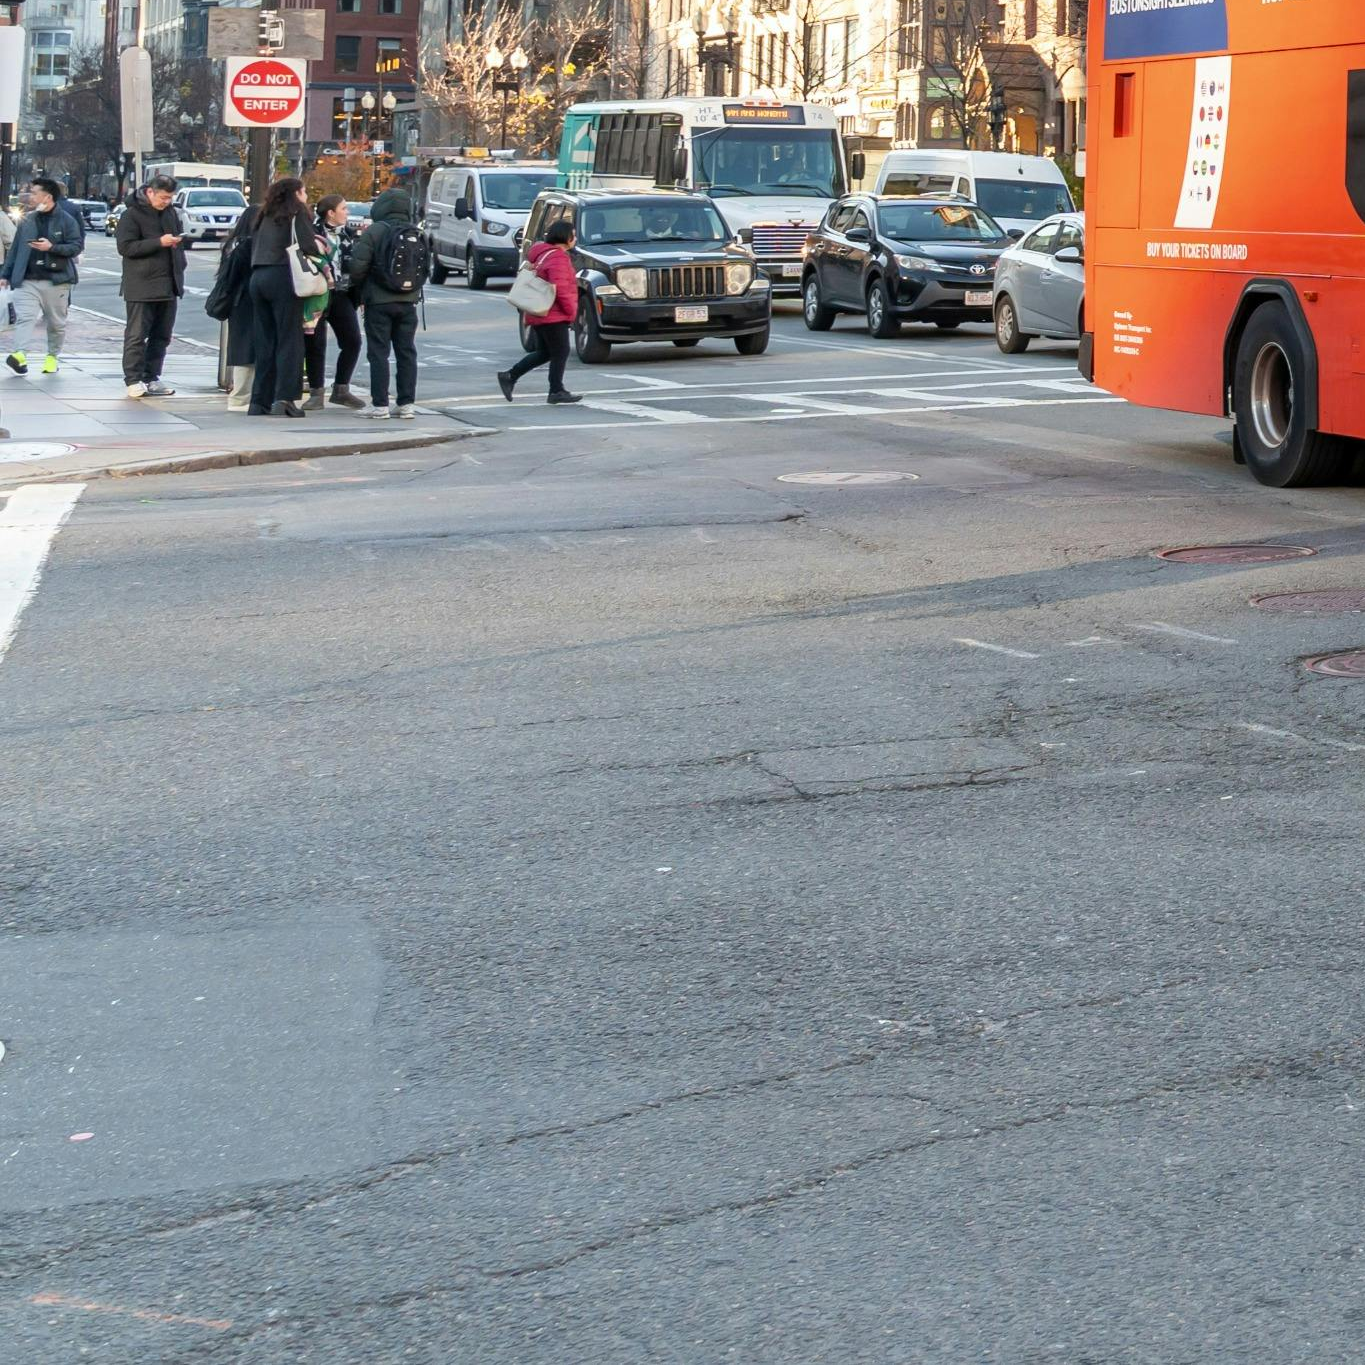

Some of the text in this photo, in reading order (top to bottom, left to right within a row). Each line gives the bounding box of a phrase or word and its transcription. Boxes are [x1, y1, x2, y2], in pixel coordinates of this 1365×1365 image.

[240, 73, 294, 84] DO NOT
[243, 100, 288, 110] ENTER
[811, 112, 823, 121] 74
[1146, 242, 1248, 260] BUY YOUR TICKETS ON BOARD
